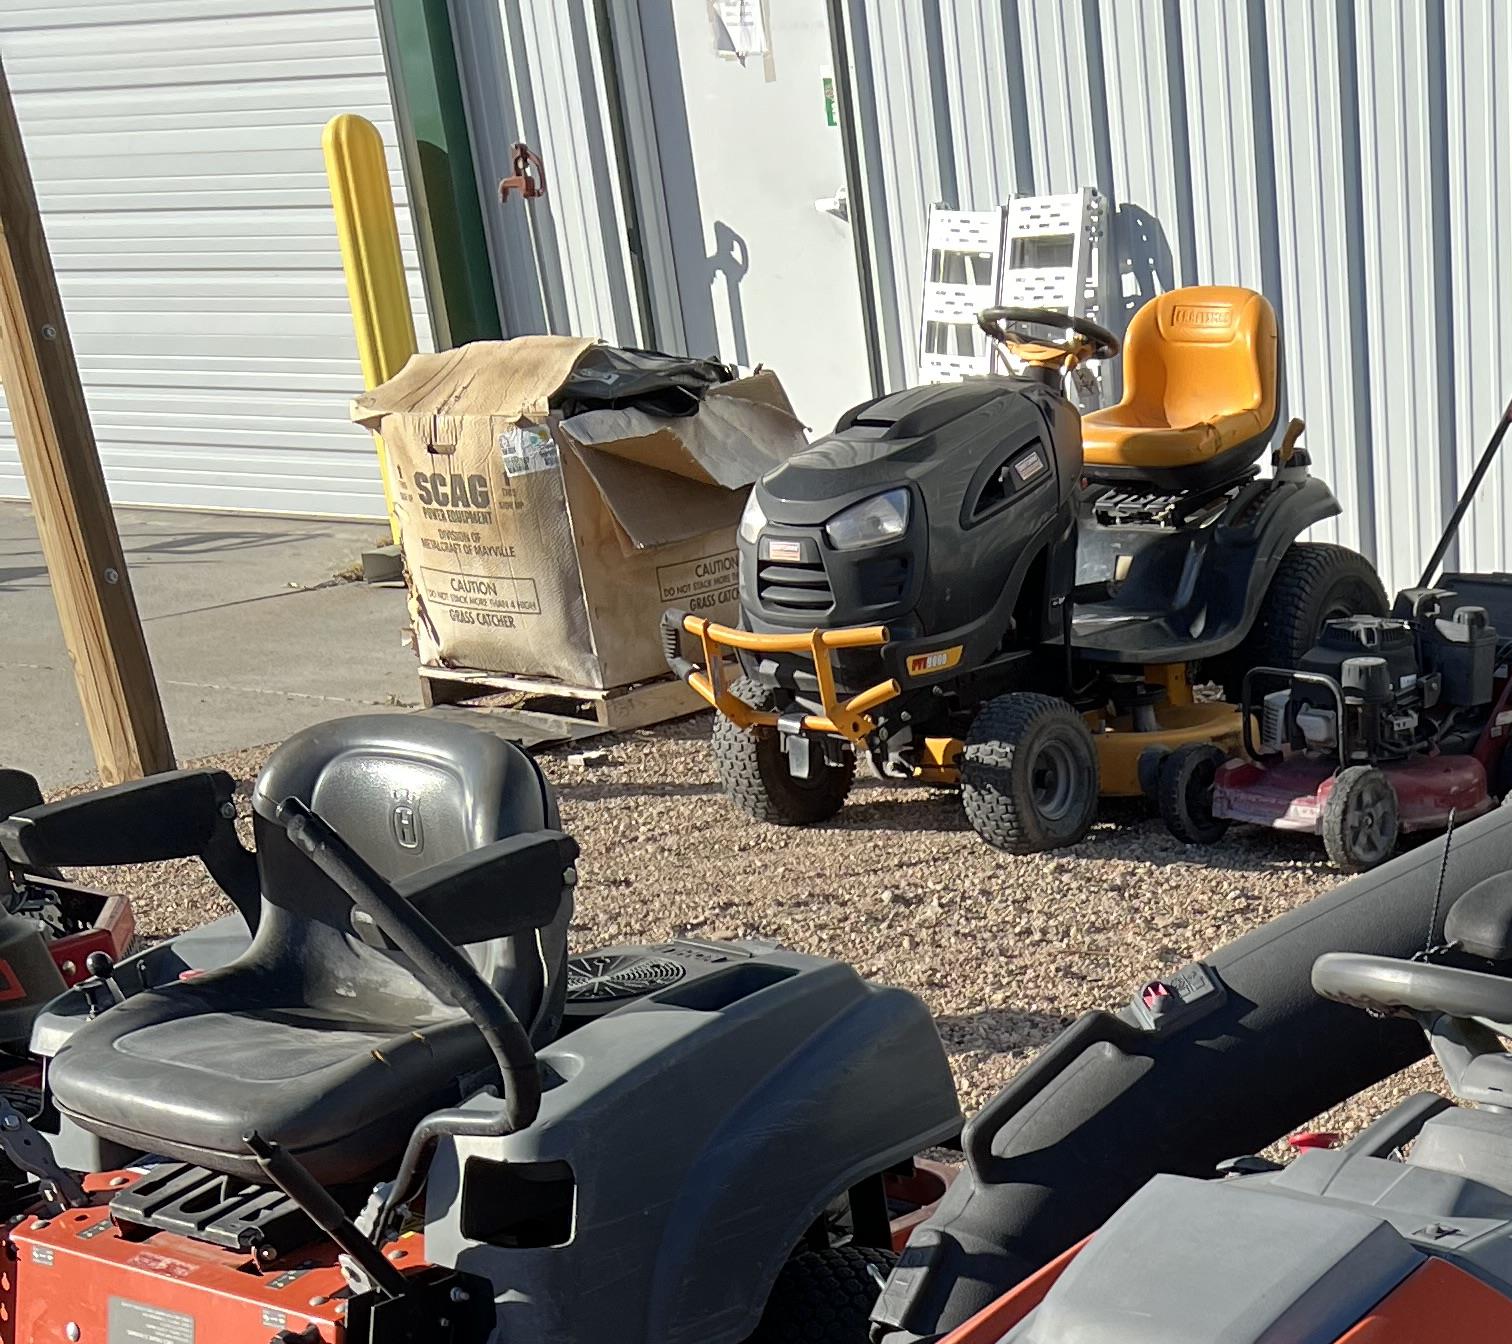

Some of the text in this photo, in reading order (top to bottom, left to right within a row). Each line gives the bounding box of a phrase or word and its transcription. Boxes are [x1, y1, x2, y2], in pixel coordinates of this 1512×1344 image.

[413, 471, 491, 508] SCAG
[423, 507, 492, 525] POWER EQUIPMENT
[438, 529, 481, 543] DIVISION OF
[463, 543, 473, 555] OF
[474, 545, 516, 558] MAYVILLE
[695, 555, 739, 578] CAUTION
[450, 578, 498, 596] CAUTION
[663, 587, 676, 597] DO
[676, 583, 692, 594] NOT
[689, 587, 739, 611] GRASS CATC
[449, 608, 517, 629] GRASS CATCHER
